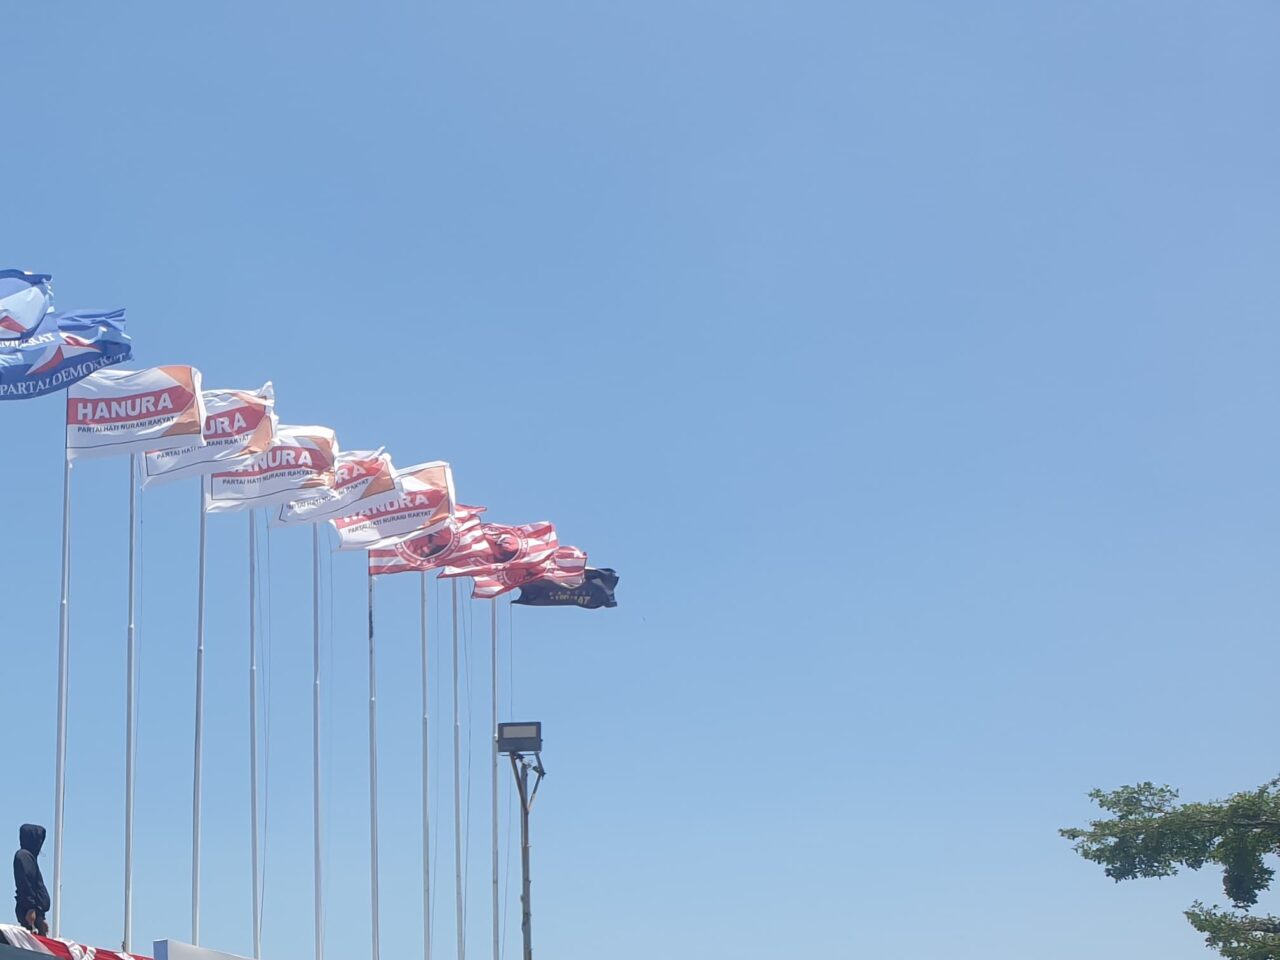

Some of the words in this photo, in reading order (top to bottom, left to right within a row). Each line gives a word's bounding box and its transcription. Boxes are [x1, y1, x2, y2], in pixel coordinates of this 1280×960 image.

[0, 380, 50, 396] PARTAI
[76, 392, 174, 421] HANURA
[77, 424, 102, 433] PARTAI
[103, 424, 119, 432] HATI
[120, 421, 147, 430] NURANI
[148, 415, 175, 425] RAKYAT
